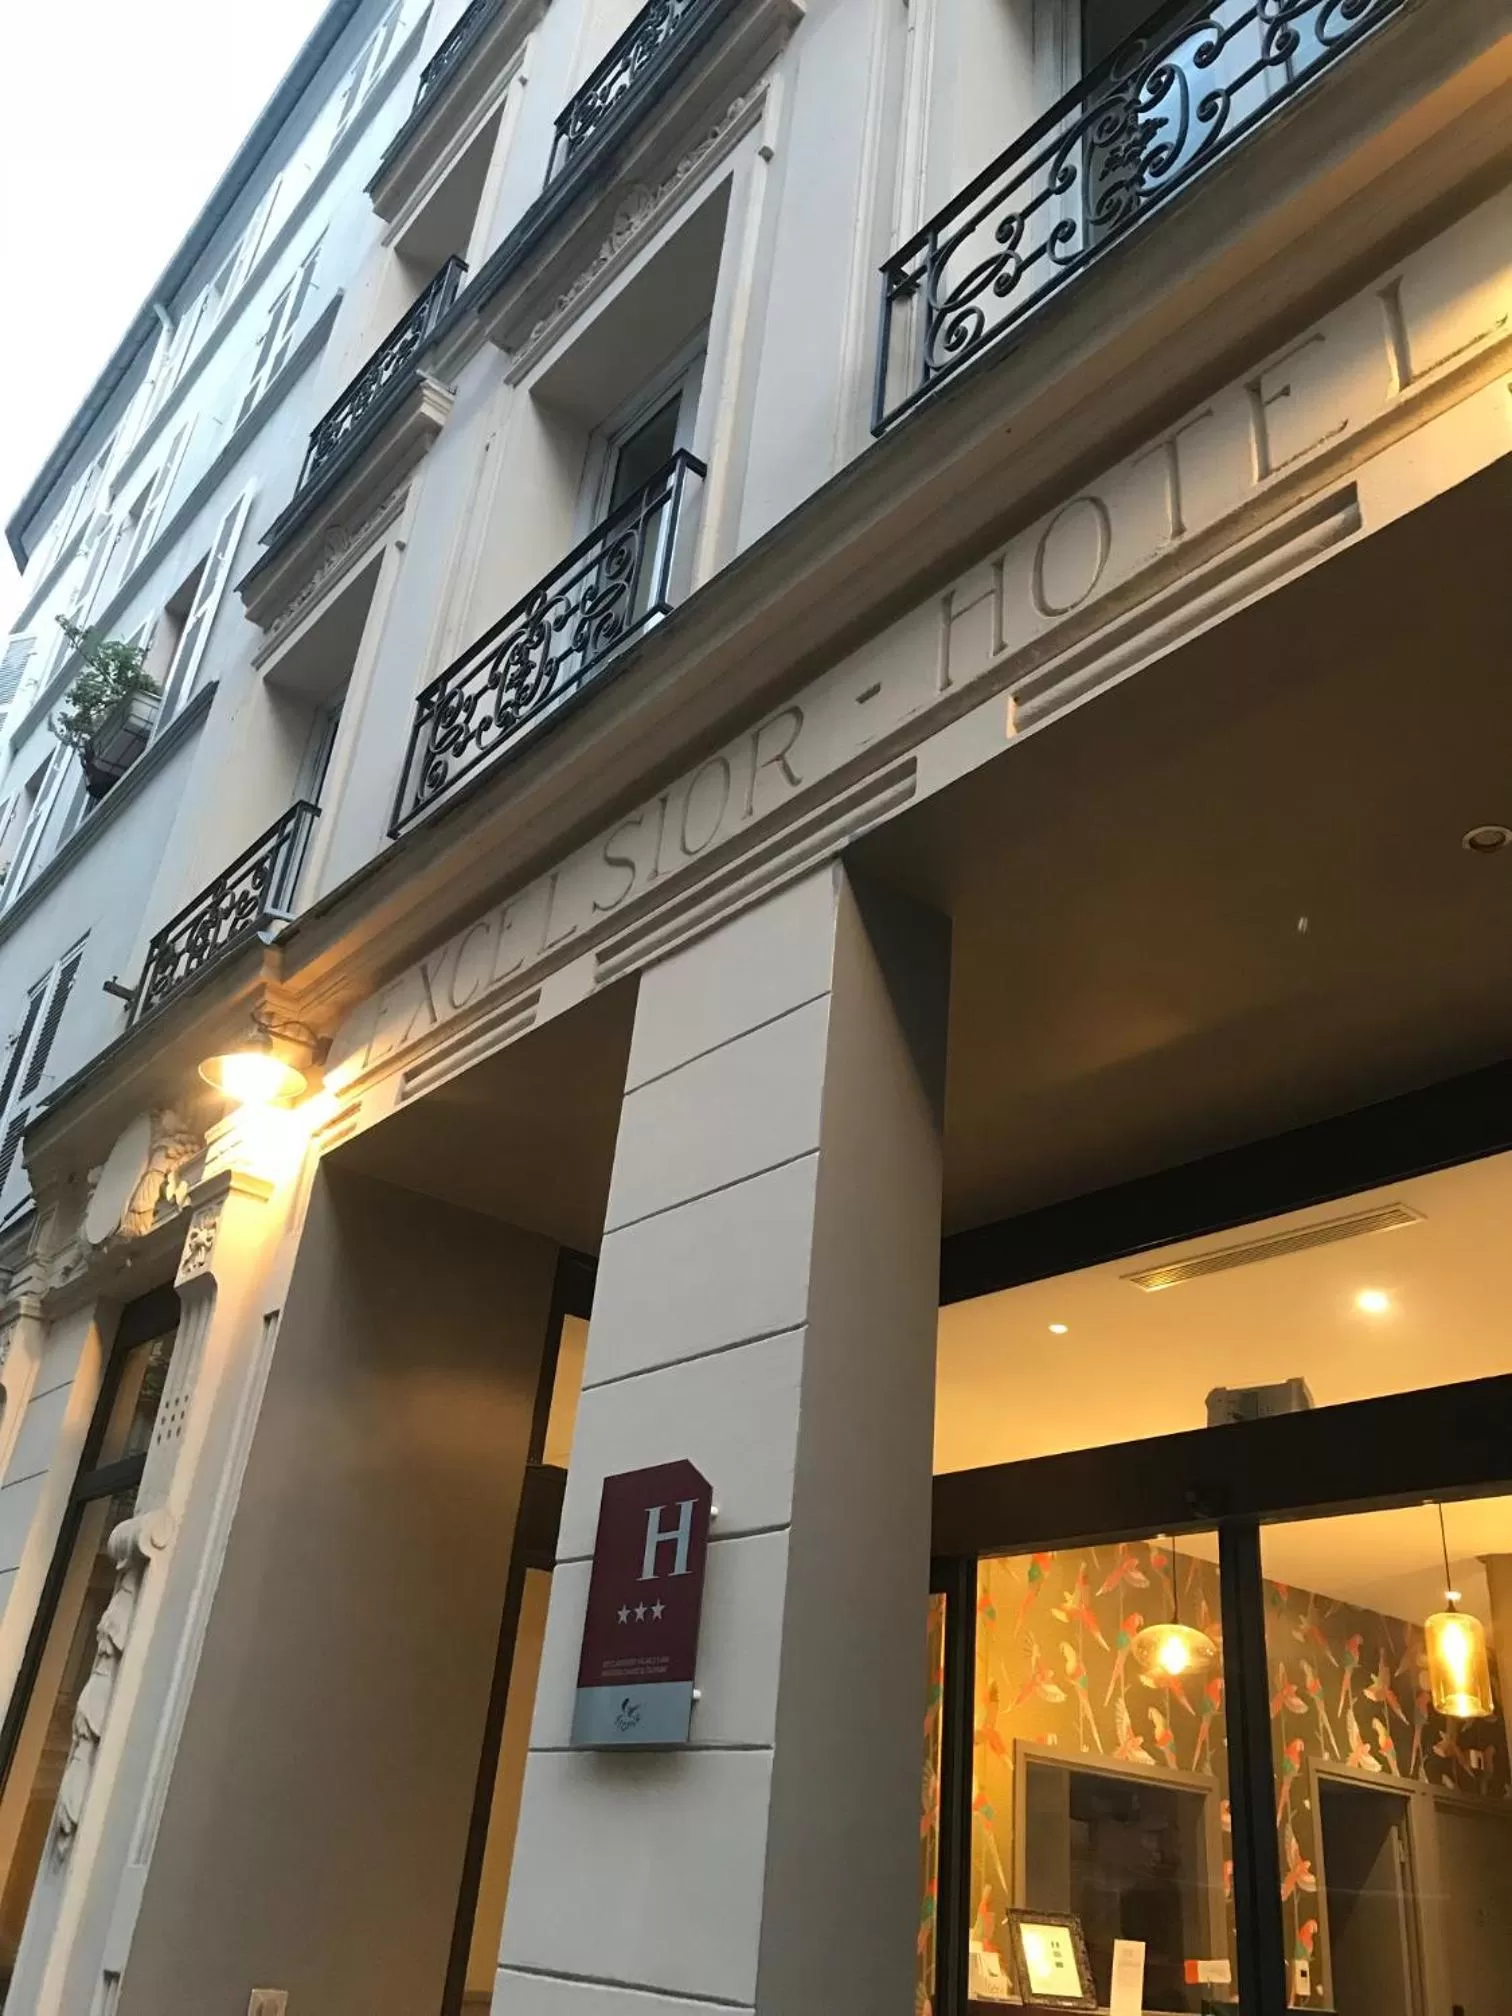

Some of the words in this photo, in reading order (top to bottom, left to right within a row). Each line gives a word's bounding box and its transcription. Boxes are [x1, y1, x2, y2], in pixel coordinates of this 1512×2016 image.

[361, 703, 805, 1070] EXCELSIOR
[936, 273, 1510, 693] HOTEL
[636, 1498, 699, 1582] H
